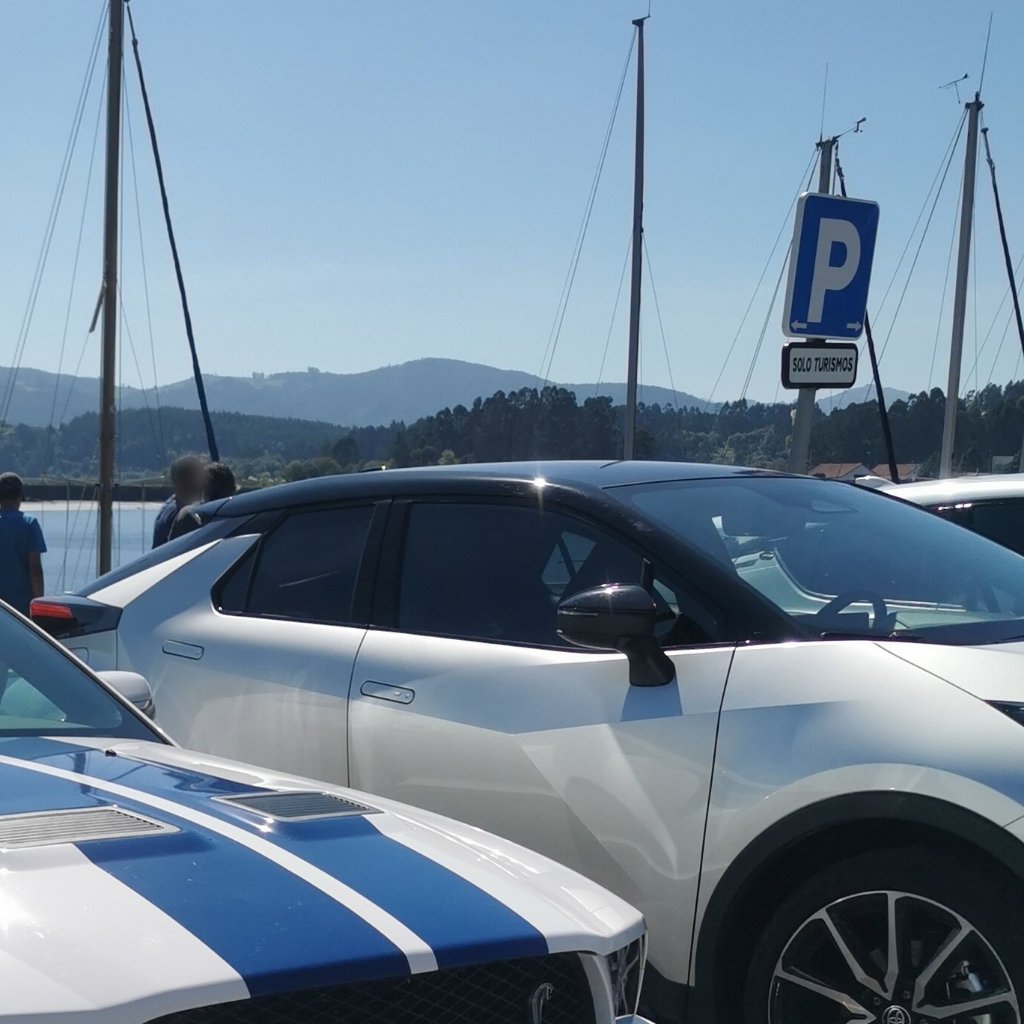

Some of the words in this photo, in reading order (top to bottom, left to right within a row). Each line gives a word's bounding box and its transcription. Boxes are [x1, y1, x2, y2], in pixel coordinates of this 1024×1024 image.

[806, 217, 861, 323] P
[792, 357, 812, 373] SOLO
[814, 357, 853, 372] TURISMOS
